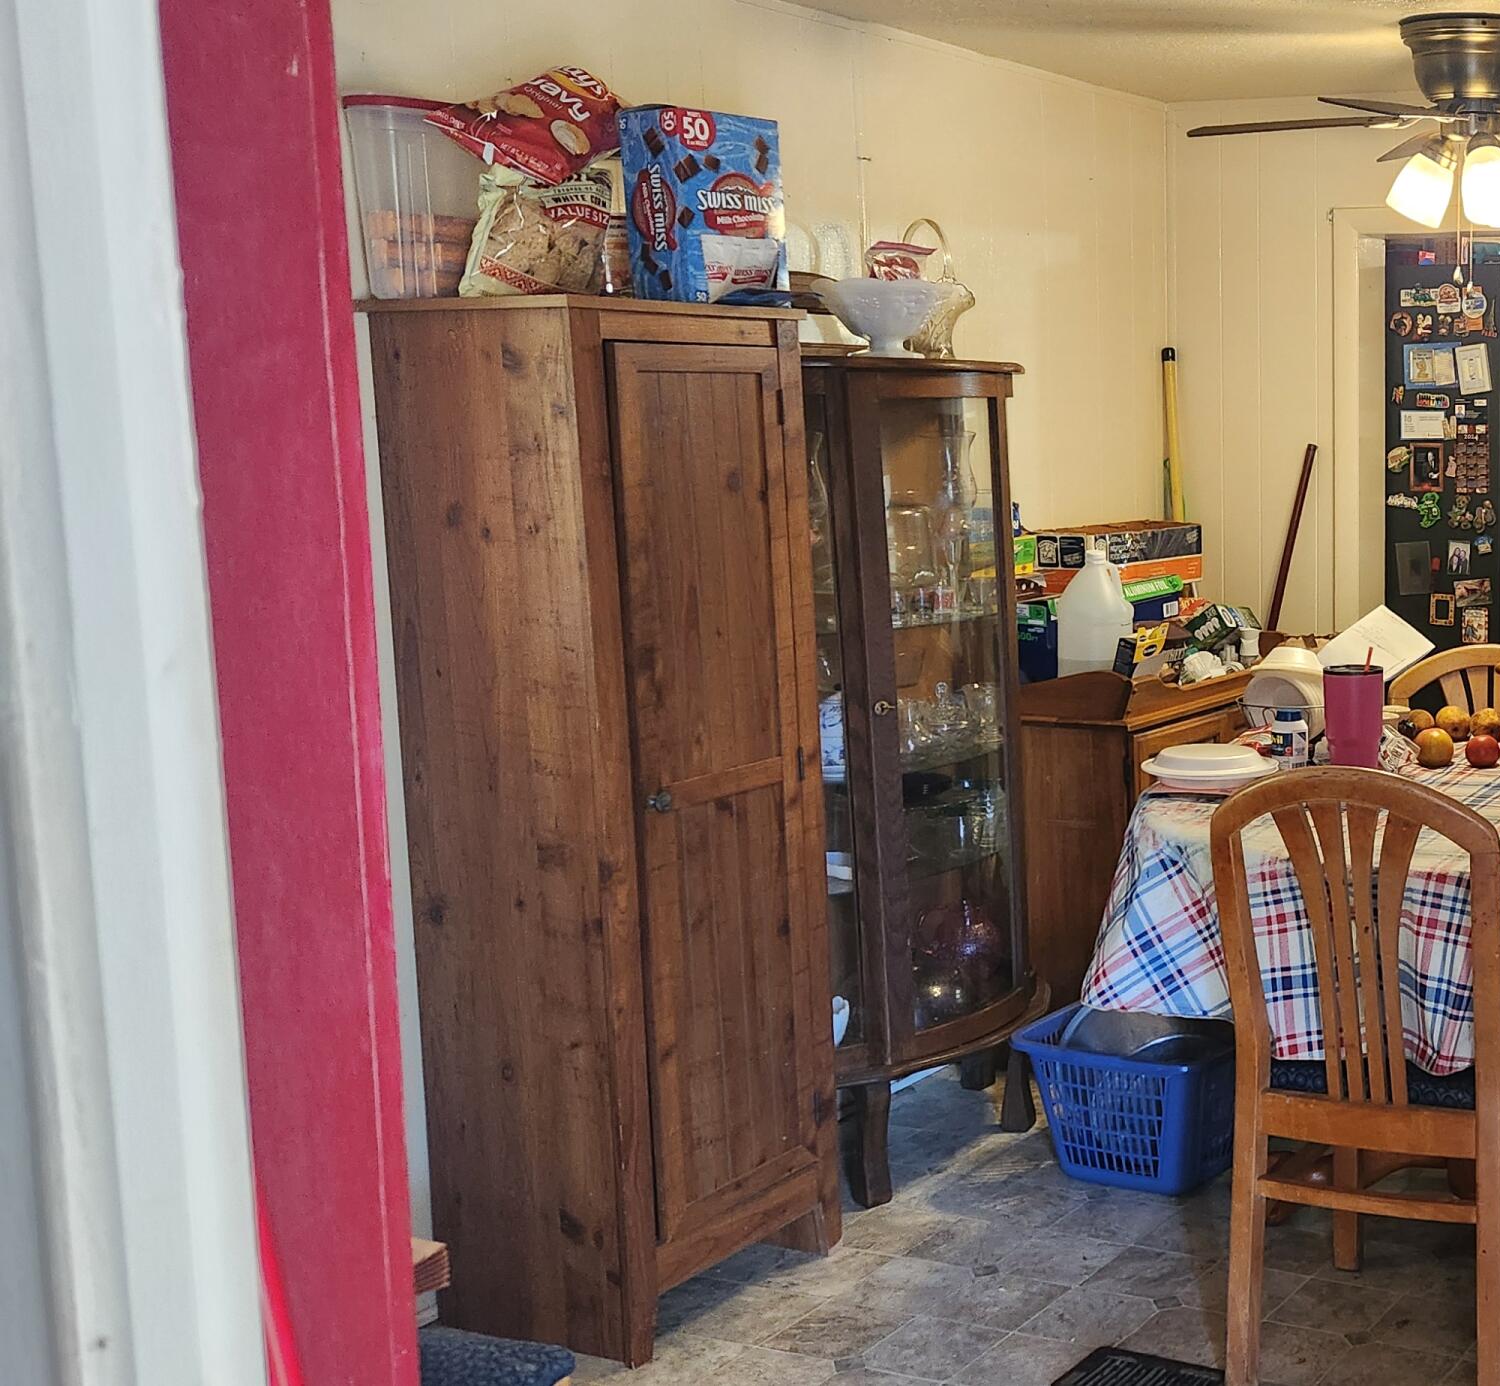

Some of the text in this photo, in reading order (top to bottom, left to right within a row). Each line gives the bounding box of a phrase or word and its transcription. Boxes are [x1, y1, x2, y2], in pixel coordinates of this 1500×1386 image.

[524, 86, 563, 110] Original
[663, 111, 675, 131] 50
[682, 116, 710, 141] 50
[551, 194, 607, 208] WHITE CORN
[550, 206, 609, 225] VALUE SIZ
[716, 213, 765, 225] Milk Chocolate
[696, 291, 707, 302] 50
[1123, 578, 1169, 598] ALUMINUM FOIL
[1271, 734, 1284, 745] vil
